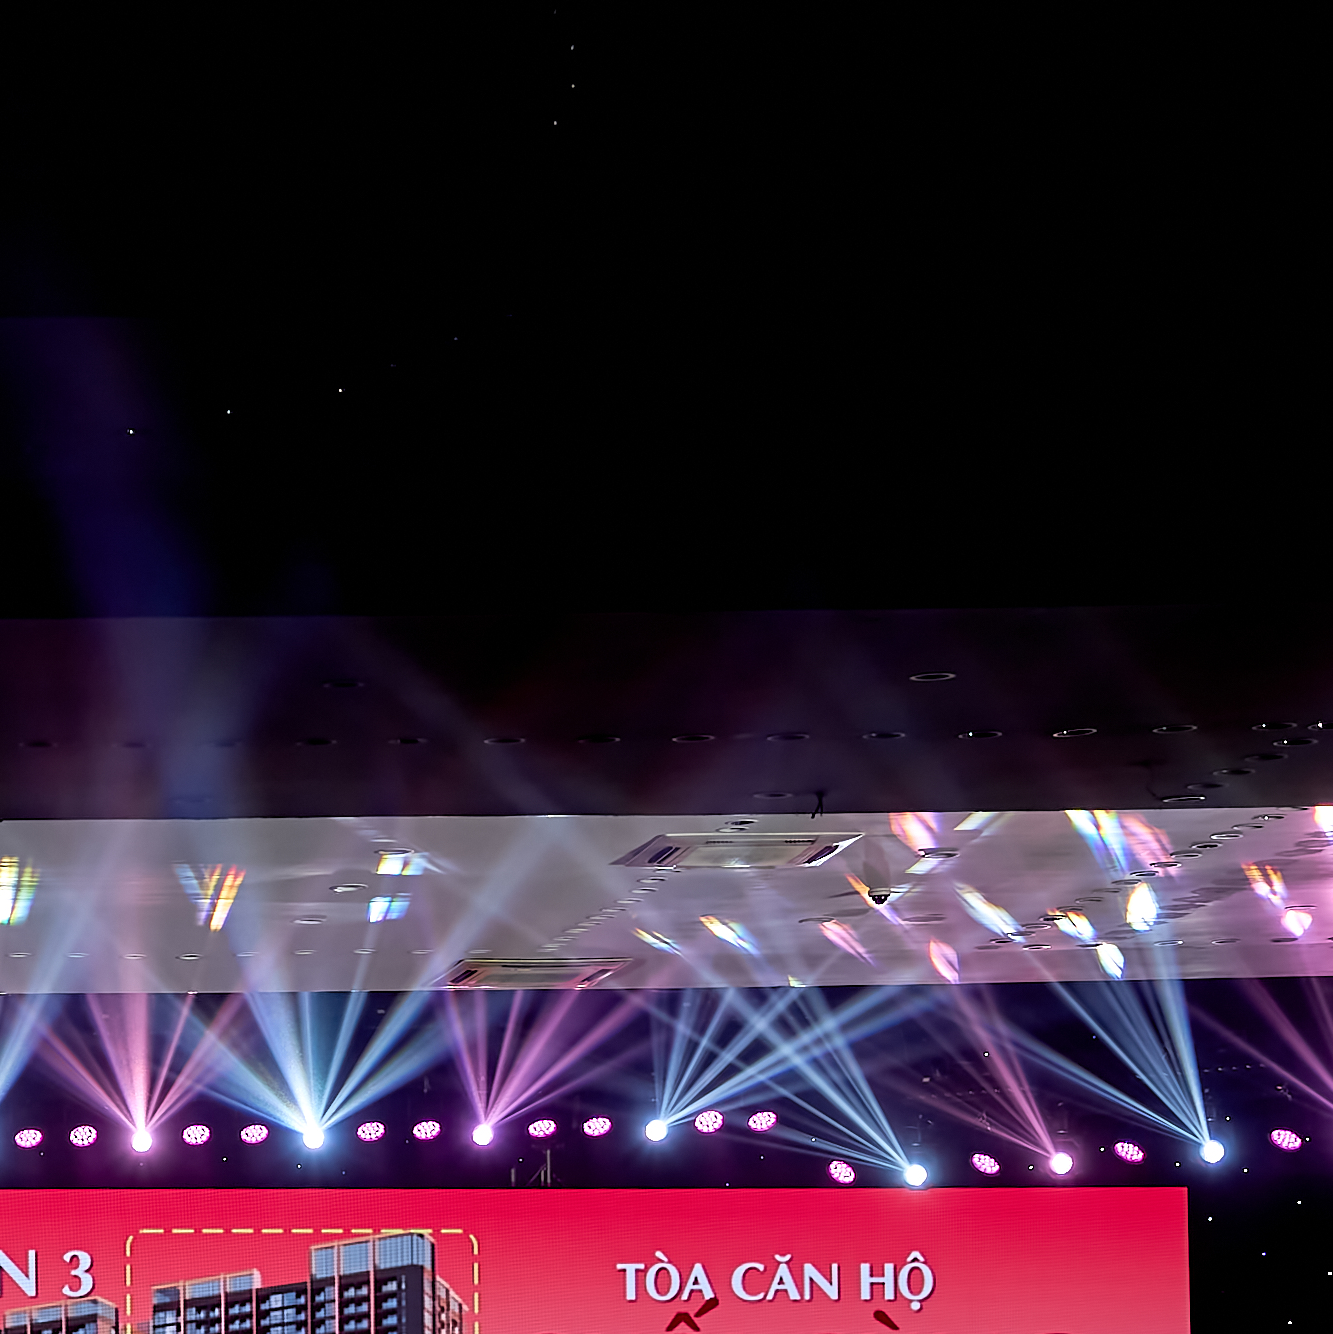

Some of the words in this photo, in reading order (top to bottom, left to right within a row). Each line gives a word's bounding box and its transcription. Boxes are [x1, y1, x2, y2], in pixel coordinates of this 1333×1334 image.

[62, 1250, 94, 1298] 3
[617, 1251, 714, 1300] TÒA
[732, 1255, 838, 1300] CĂN
[861, 1251, 933, 1310] HỘ
